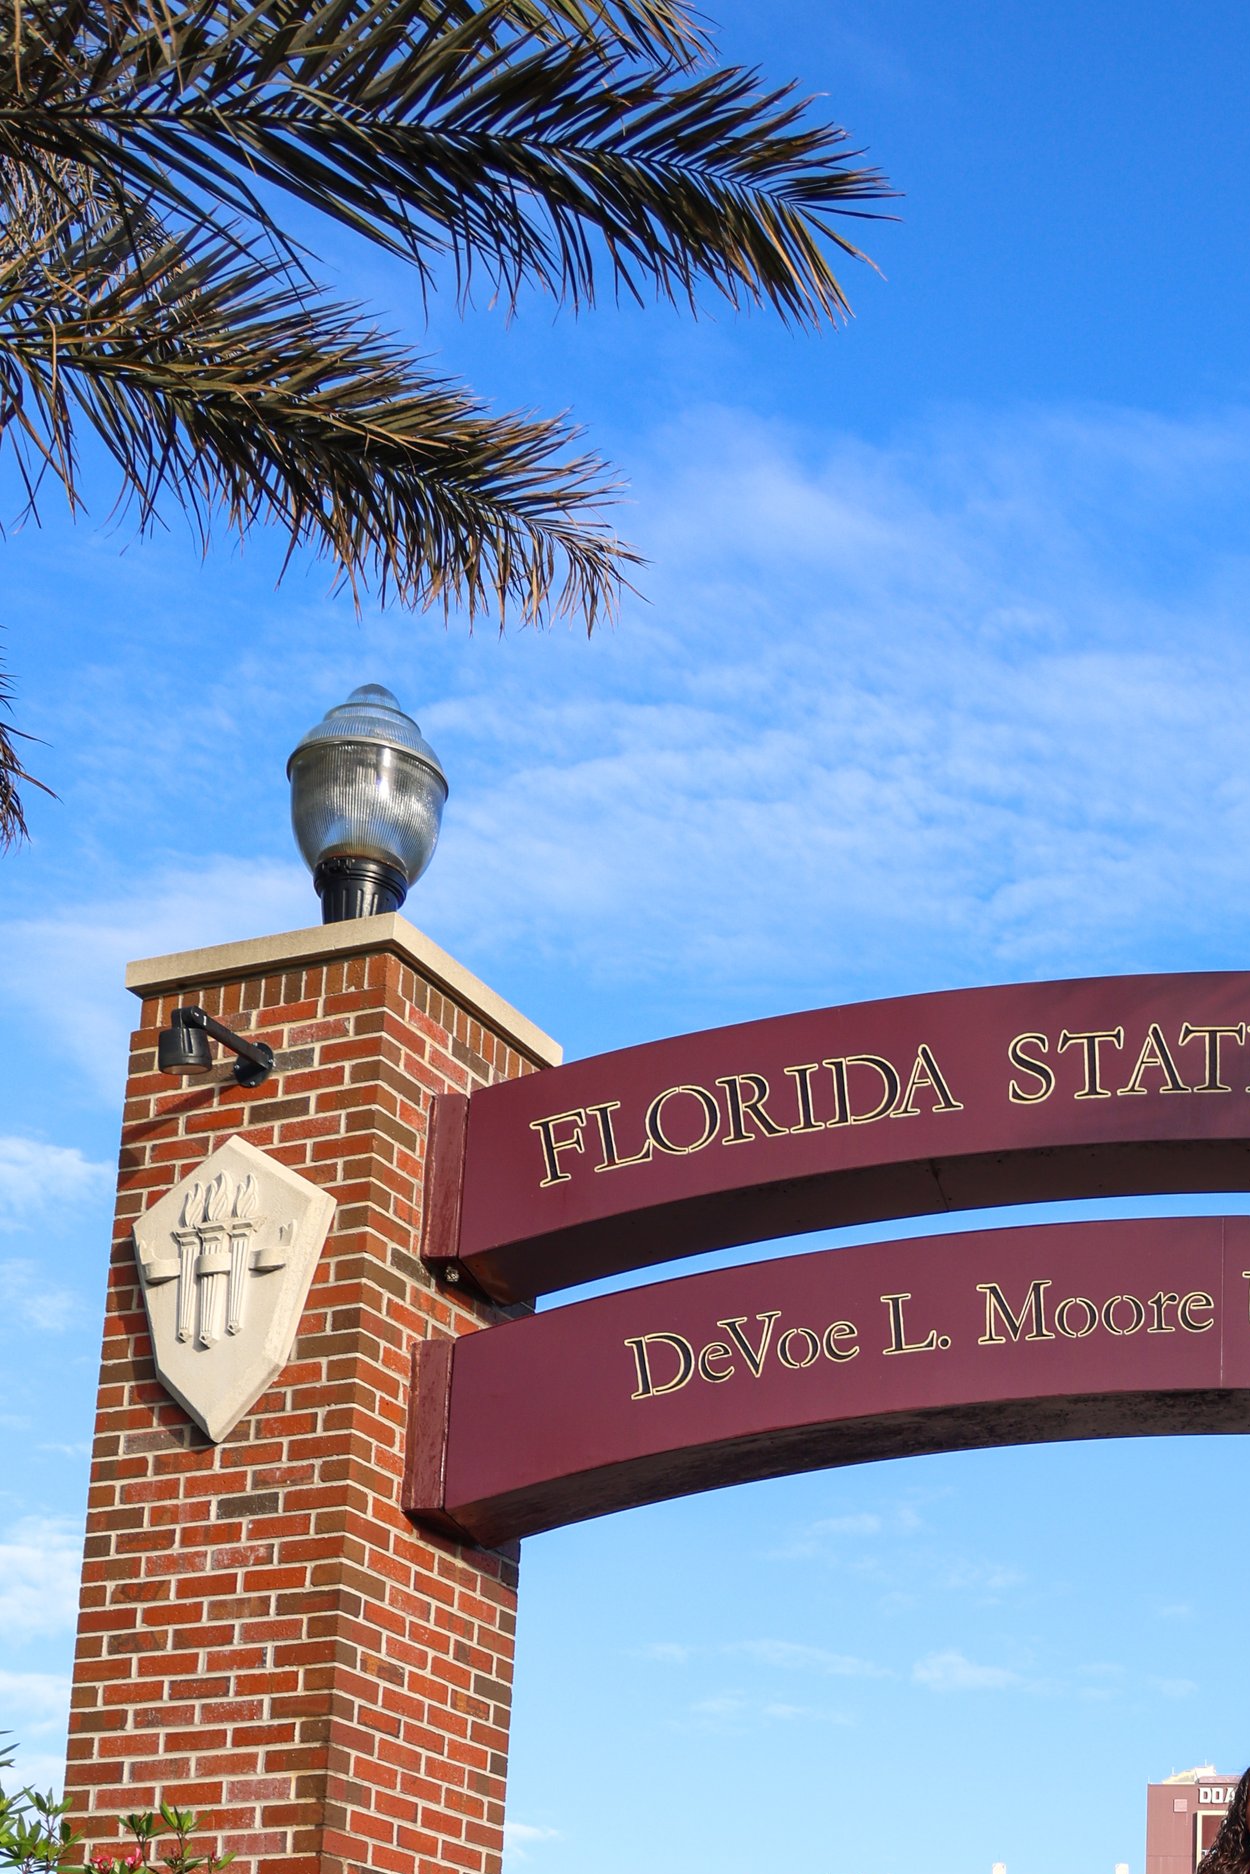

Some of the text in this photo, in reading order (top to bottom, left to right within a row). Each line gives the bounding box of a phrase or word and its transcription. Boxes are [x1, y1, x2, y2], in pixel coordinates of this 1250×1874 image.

[530, 1044, 964, 1187] FLORIDA
[624, 1311, 860, 1400] DeVoe
[880, 1293, 952, 1356] L.
[976, 1279, 1215, 1345] Moore
[1199, 1787, 1236, 1804] DOA
